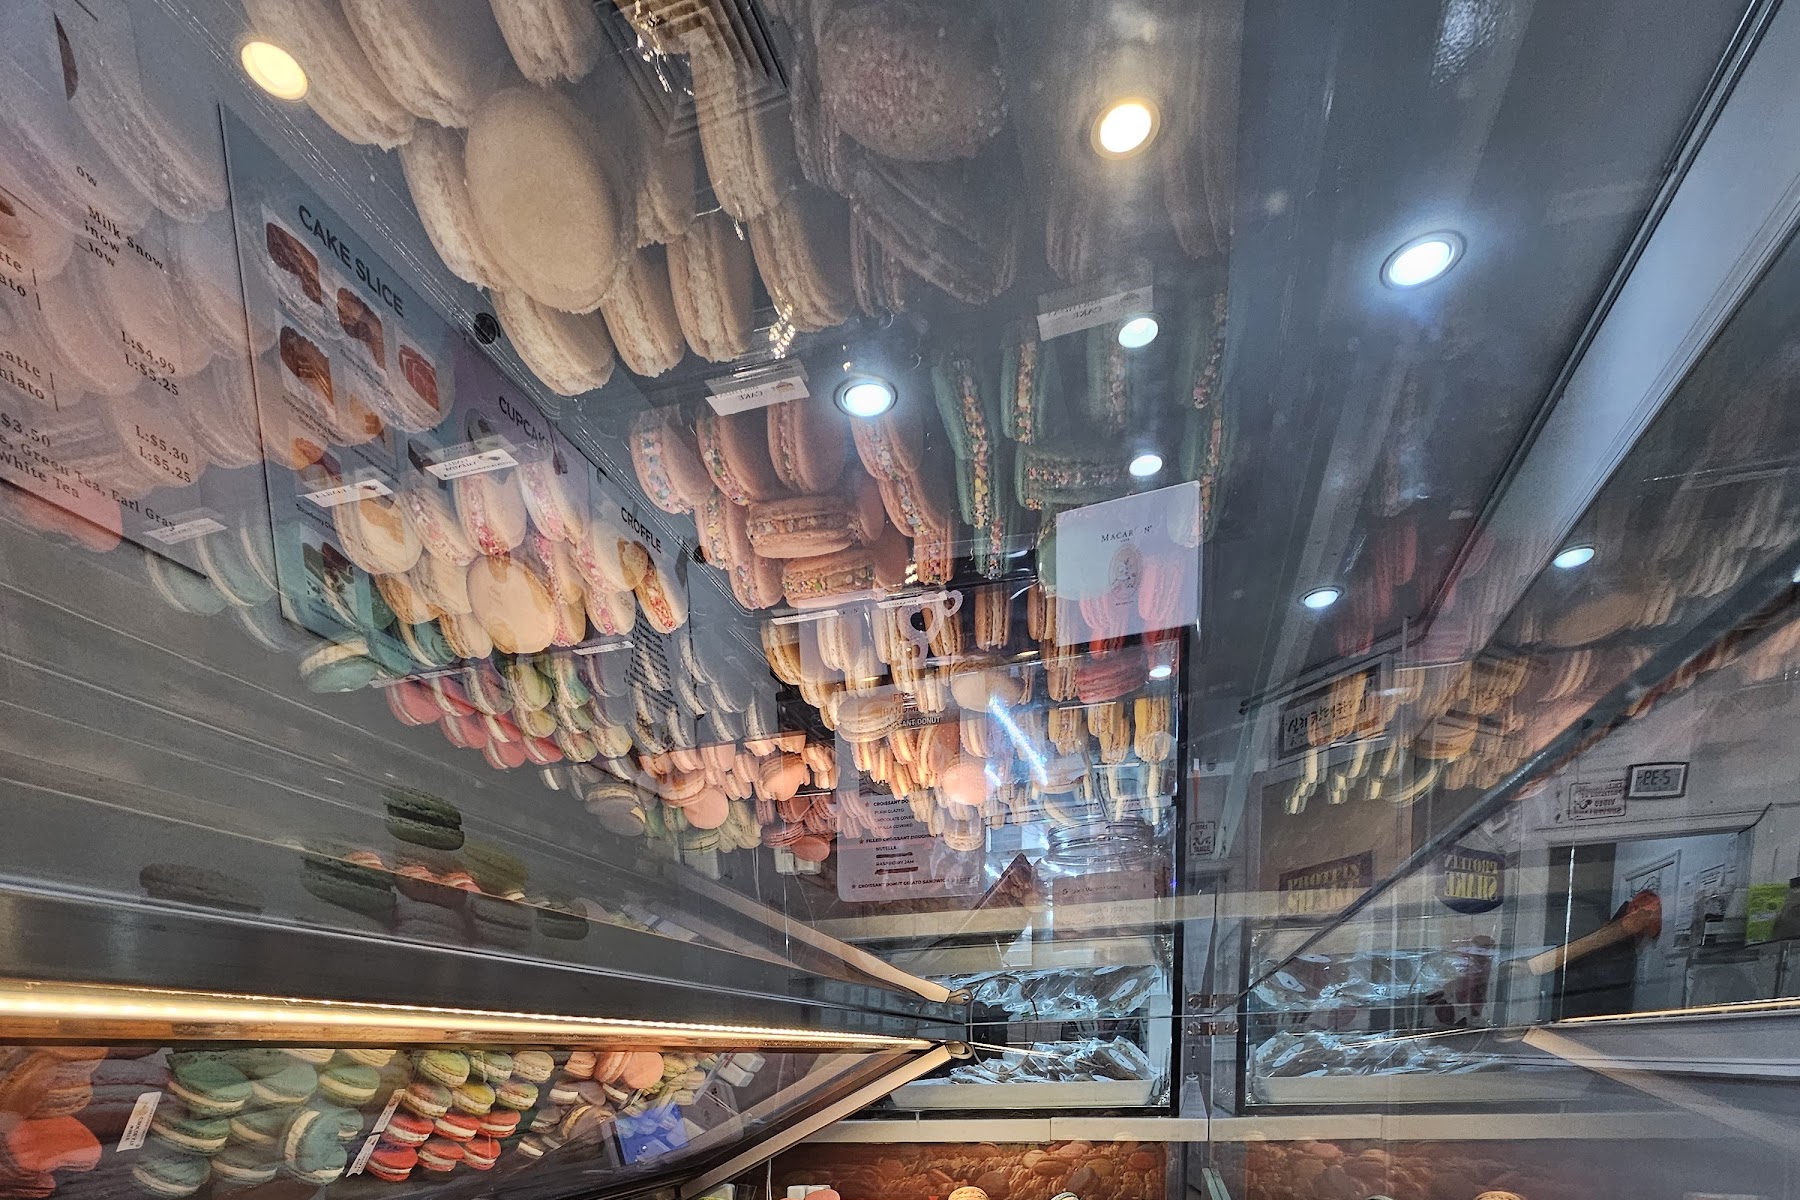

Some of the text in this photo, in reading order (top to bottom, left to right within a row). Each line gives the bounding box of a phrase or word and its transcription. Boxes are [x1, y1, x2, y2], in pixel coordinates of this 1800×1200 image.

[88, 205, 163, 269] Milk Snow
[299, 204, 404, 318] CAKE SLICE
[0, 350, 41, 378] atte
[122, 330, 176, 374] L:$4.99
[125, 353, 179, 396] L:$5.25
[1, 412, 51, 448] $3.50
[499, 396, 547, 447] CUPCAK
[135, 425, 188, 464] L:$5.30
[139, 446, 191, 483] L:$5.25
[0, 451, 80, 499] White Tea
[21, 443, 69, 477] Green
[75, 470, 106, 497] Tea,
[111, 489, 140, 513] Earl
[145, 507, 176, 531] Gray
[620, 506, 662, 554] CROFFLE
[917, 716, 940, 725] DONUT
